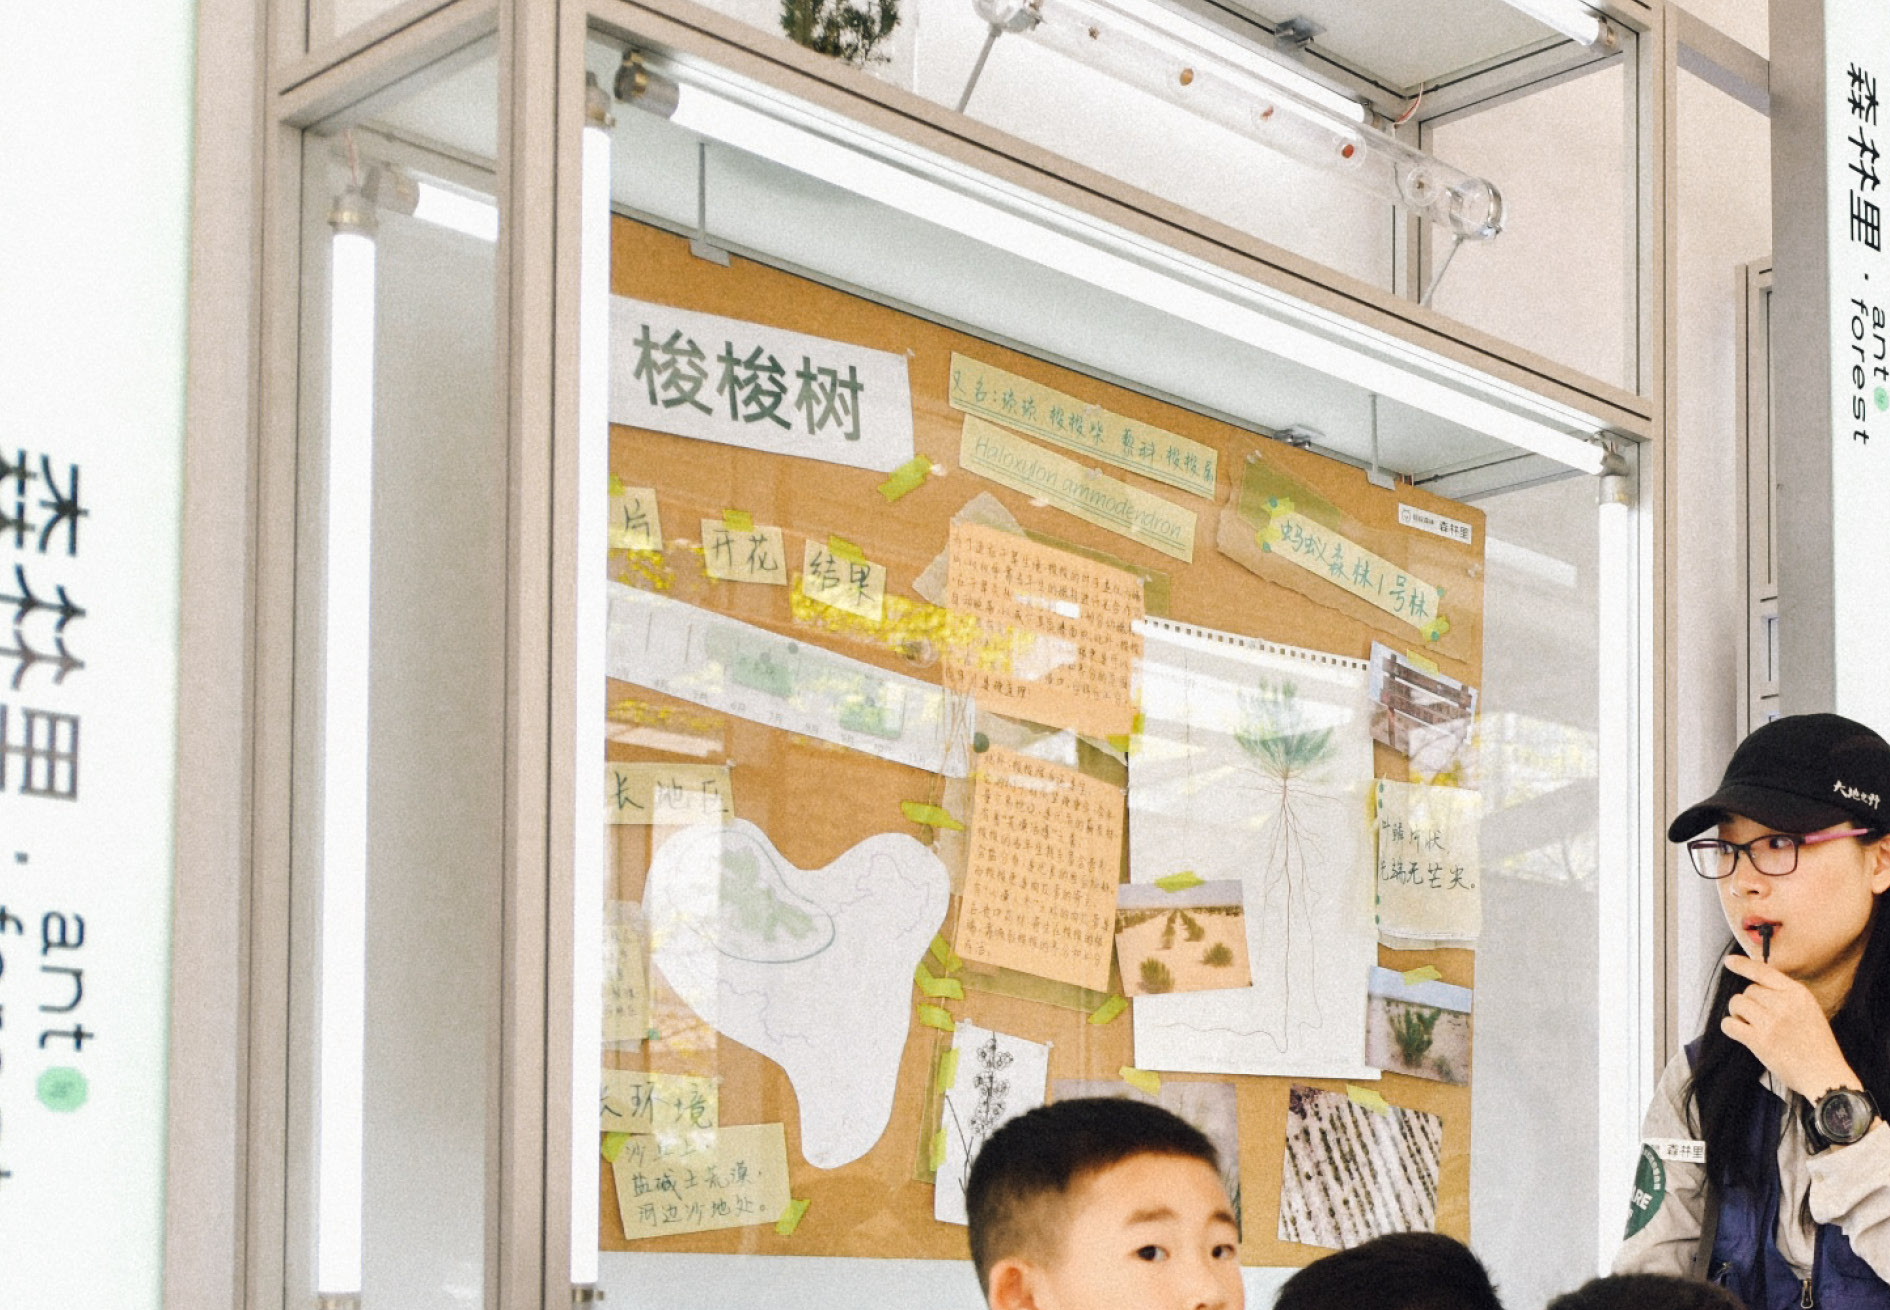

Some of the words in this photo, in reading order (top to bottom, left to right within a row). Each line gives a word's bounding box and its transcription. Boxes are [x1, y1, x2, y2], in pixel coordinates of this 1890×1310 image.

[1847, 61, 1882, 253] 森林里
[632, 323, 864, 442] 梭梭树
[1851, 297, 1869, 446] forest
[1872, 304, 1890, 381] ant
[975, 436, 1058, 487] Haloxylon
[1062, 476, 1182, 539] ammodendron
[711, 529, 779, 574] 开花
[808, 549, 875, 602] 结果
[1280, 519, 1429, 618] 蚂蚁森林1号林
[39, 911, 94, 1052] ant
